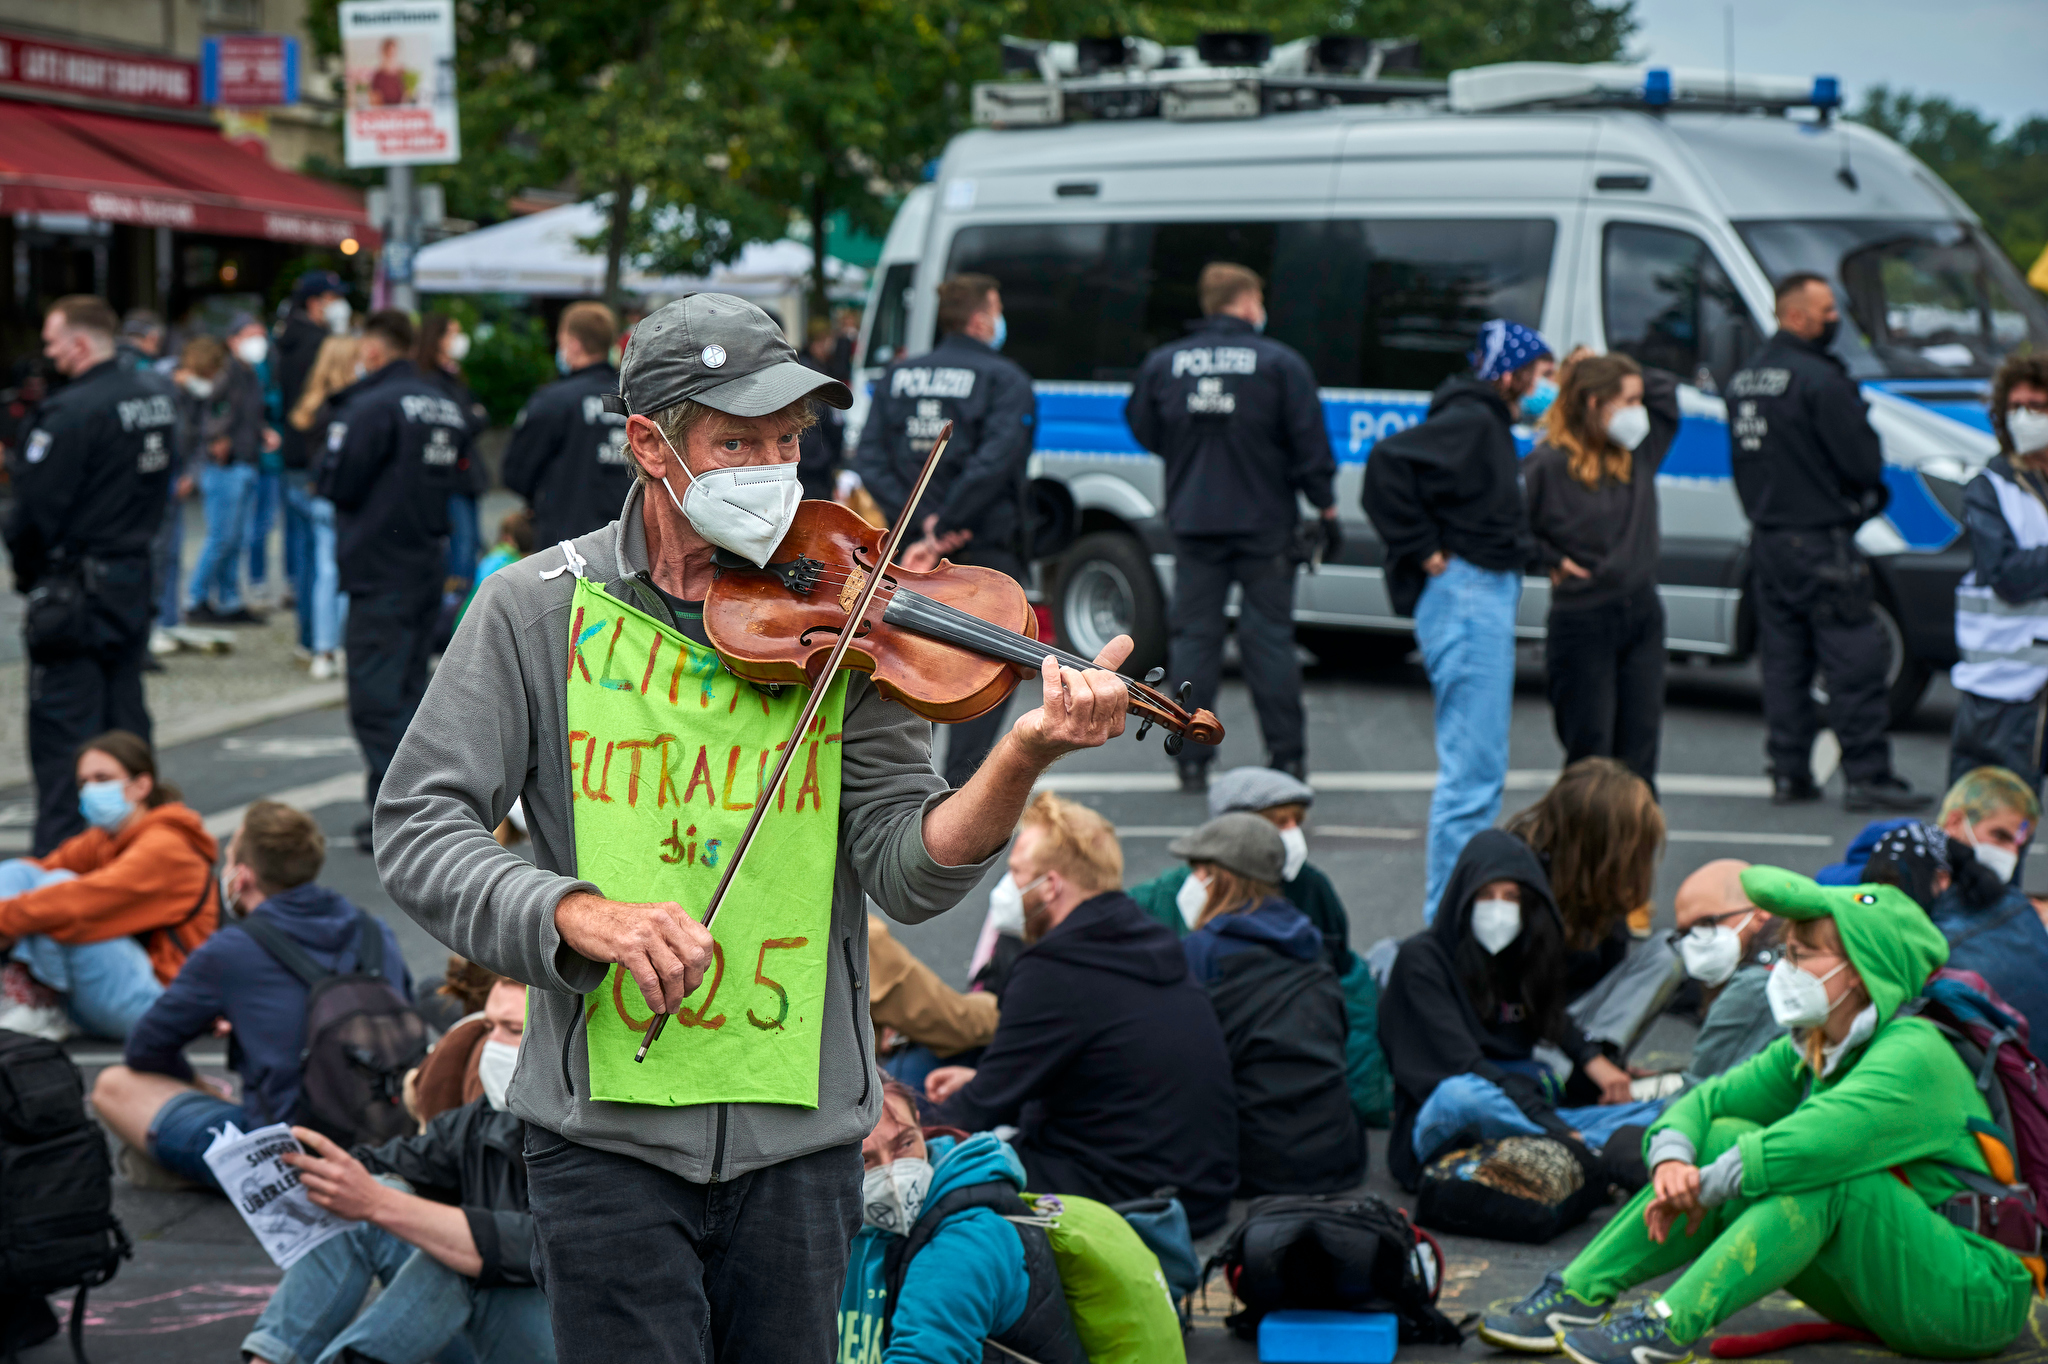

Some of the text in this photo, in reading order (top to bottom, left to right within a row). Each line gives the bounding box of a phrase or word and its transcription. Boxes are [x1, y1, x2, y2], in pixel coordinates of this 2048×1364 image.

[1172, 346, 1257, 378] POLIZEI
[890, 366, 976, 399] POLIZEI
[586, 936, 810, 1032] 025
